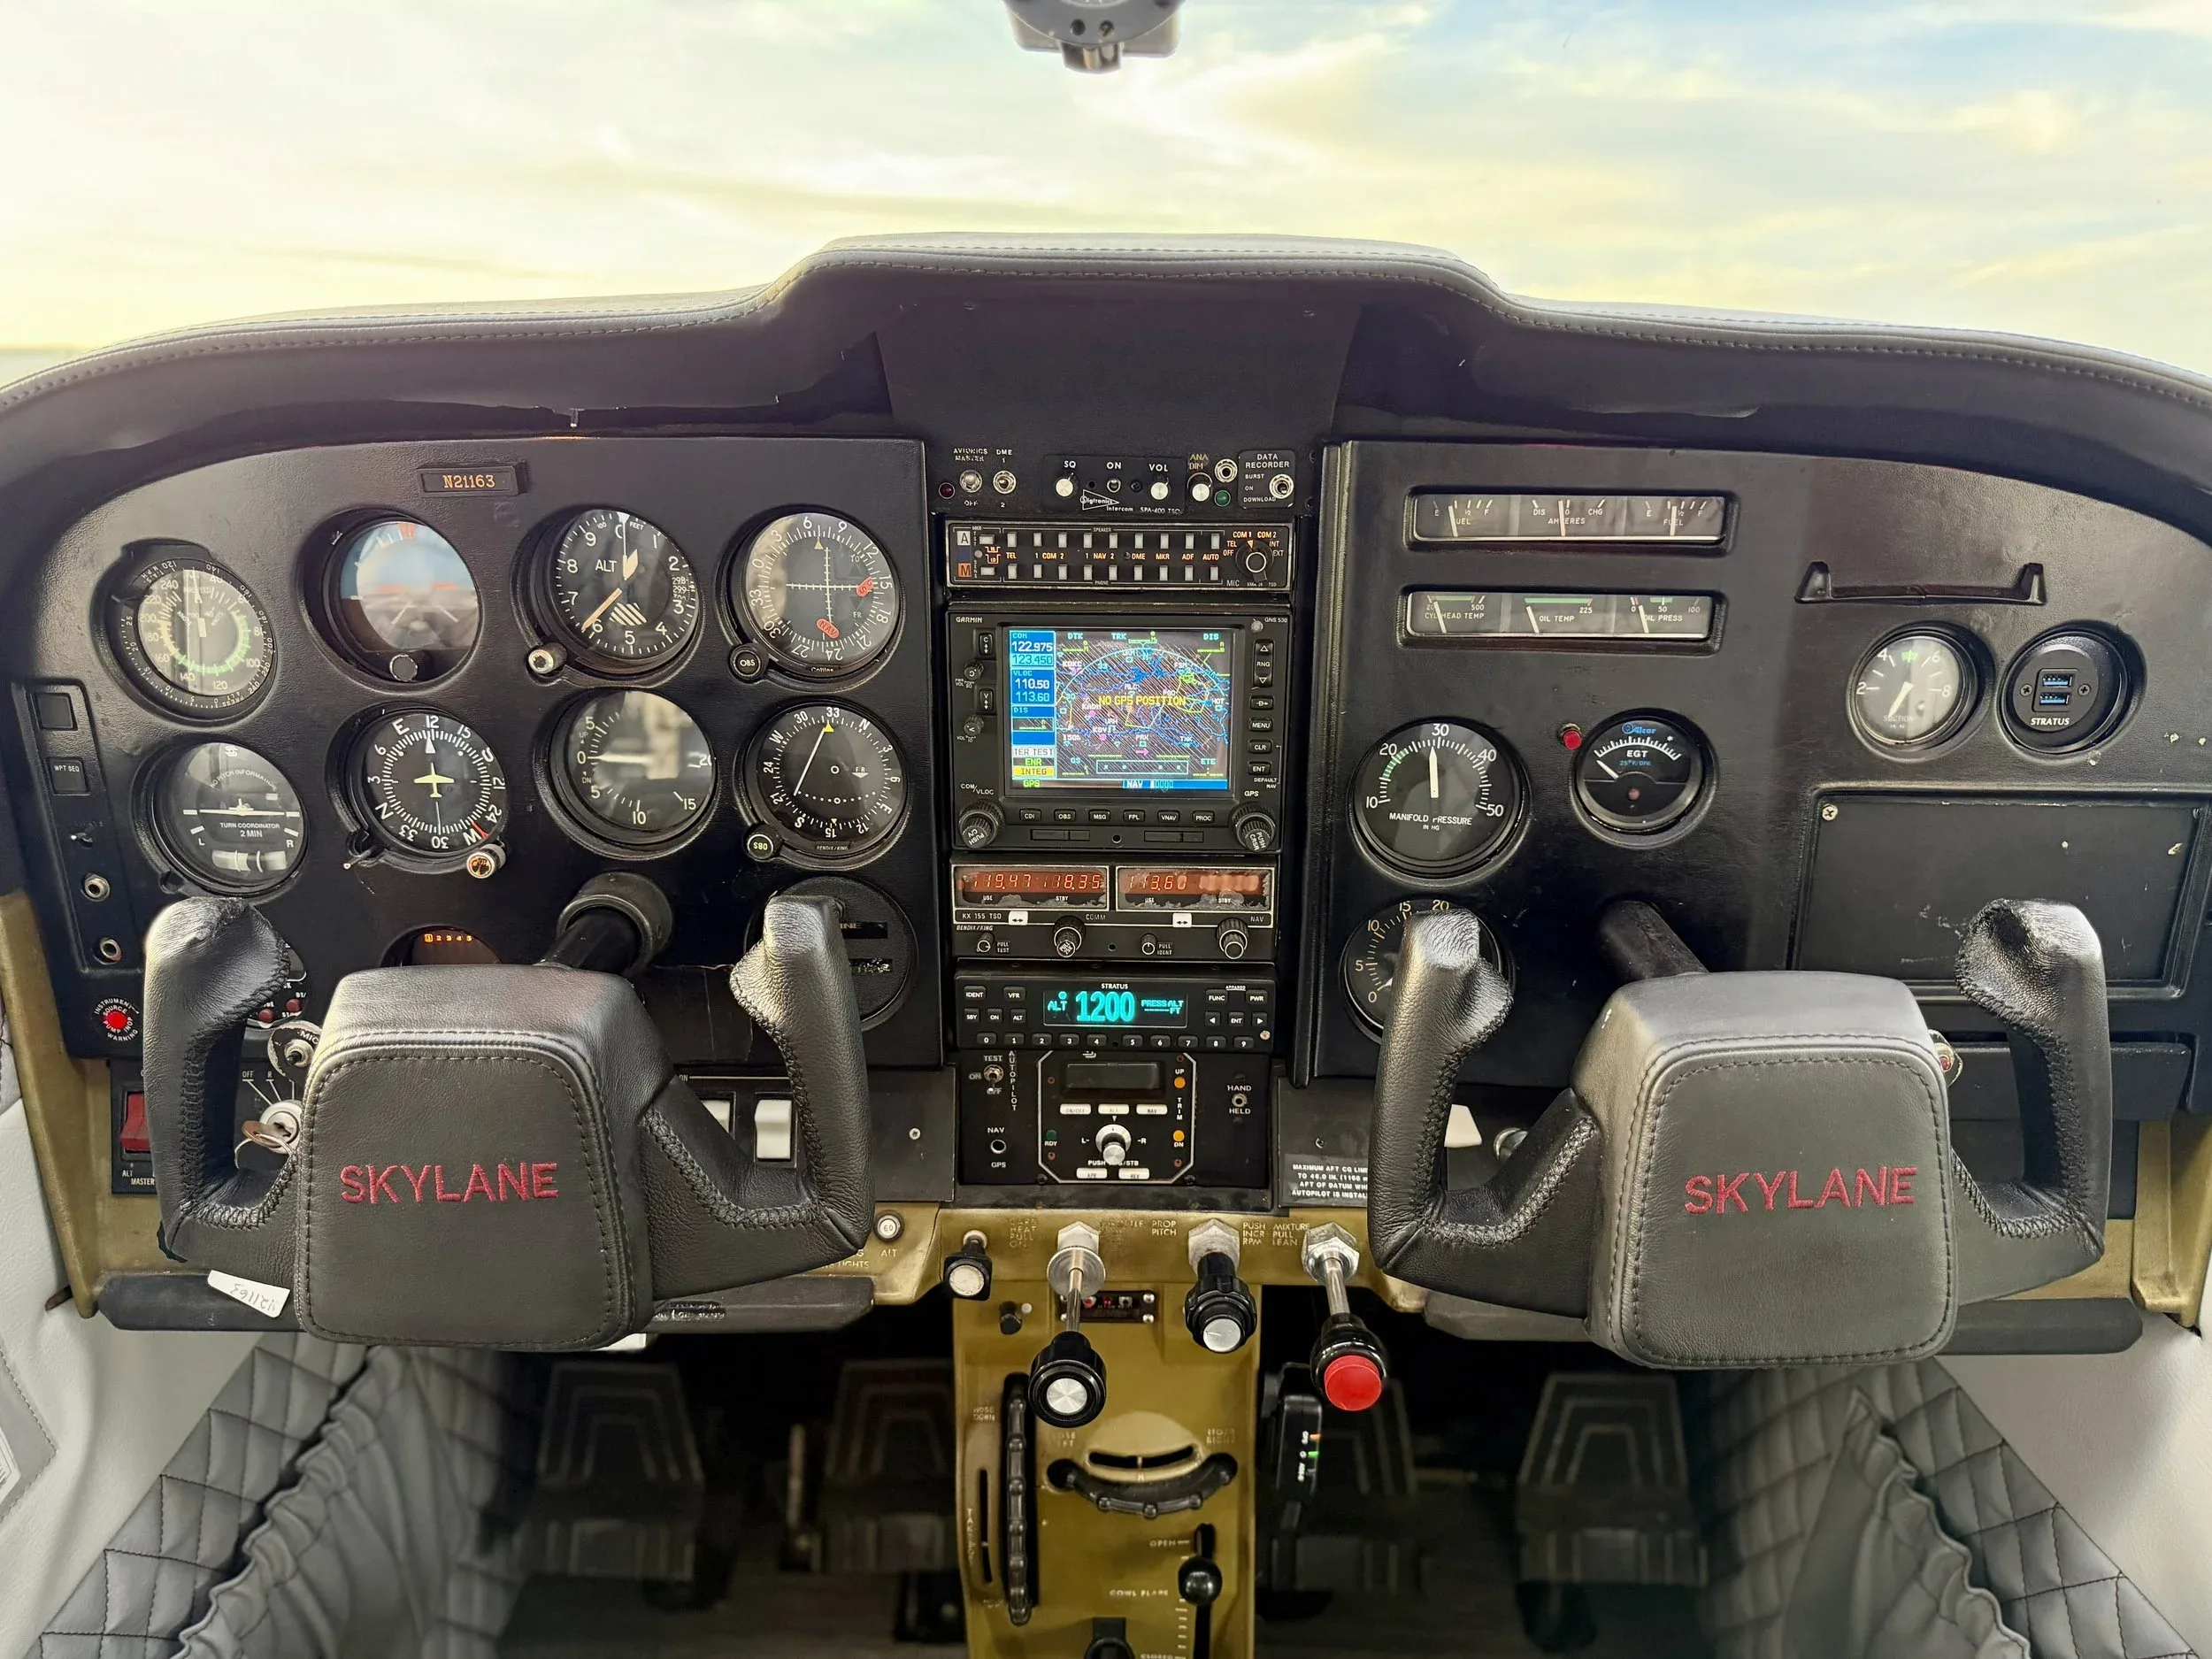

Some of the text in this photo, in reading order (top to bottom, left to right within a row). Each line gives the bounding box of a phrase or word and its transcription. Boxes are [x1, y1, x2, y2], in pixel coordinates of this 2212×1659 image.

[1106, 461, 1122, 470] ON
[442, 474, 495, 488] N21163
[595, 560, 617, 572] ALT
[161, 580, 179, 589] 240
[140, 613, 157, 622] 200
[818, 621, 837, 635] NAV
[1012, 641, 1053, 652] 122.975
[154, 653, 170, 662] 160
[1012, 656, 1053, 664] 123.450
[180, 672, 195, 681] 140
[213, 680, 227, 690] 120
[1015, 679, 1050, 688] 110.50
[1016, 692, 1050, 702] 113.60
[1099, 696, 1186, 706] NO GPS POSITION
[426, 716, 439, 728] 12
[1431, 724, 1449, 736] 30
[1379, 743, 1397, 756] 20
[1478, 749, 1497, 762] 40
[1365, 796, 1378, 809] 10
[1486, 805, 1503, 817] 50
[633, 811, 646, 825] 10
[1130, 875, 1187, 891] 113.60
[94, 998, 133, 1015] INSTRUMENT
[104, 1004, 127, 1017] SOURCE
[1048, 1001, 1067, 1010] ALT
[1075, 990, 1135, 1022] 1200
[103, 1017, 133, 1033] PUMP INOP
[107, 1029, 138, 1041] WARNING
[1009, 1050, 1018, 1111] AUTOPILOT
[340, 1162, 559, 1204] SKYLANE
[1684, 1165, 1917, 1215] SKYLANE
